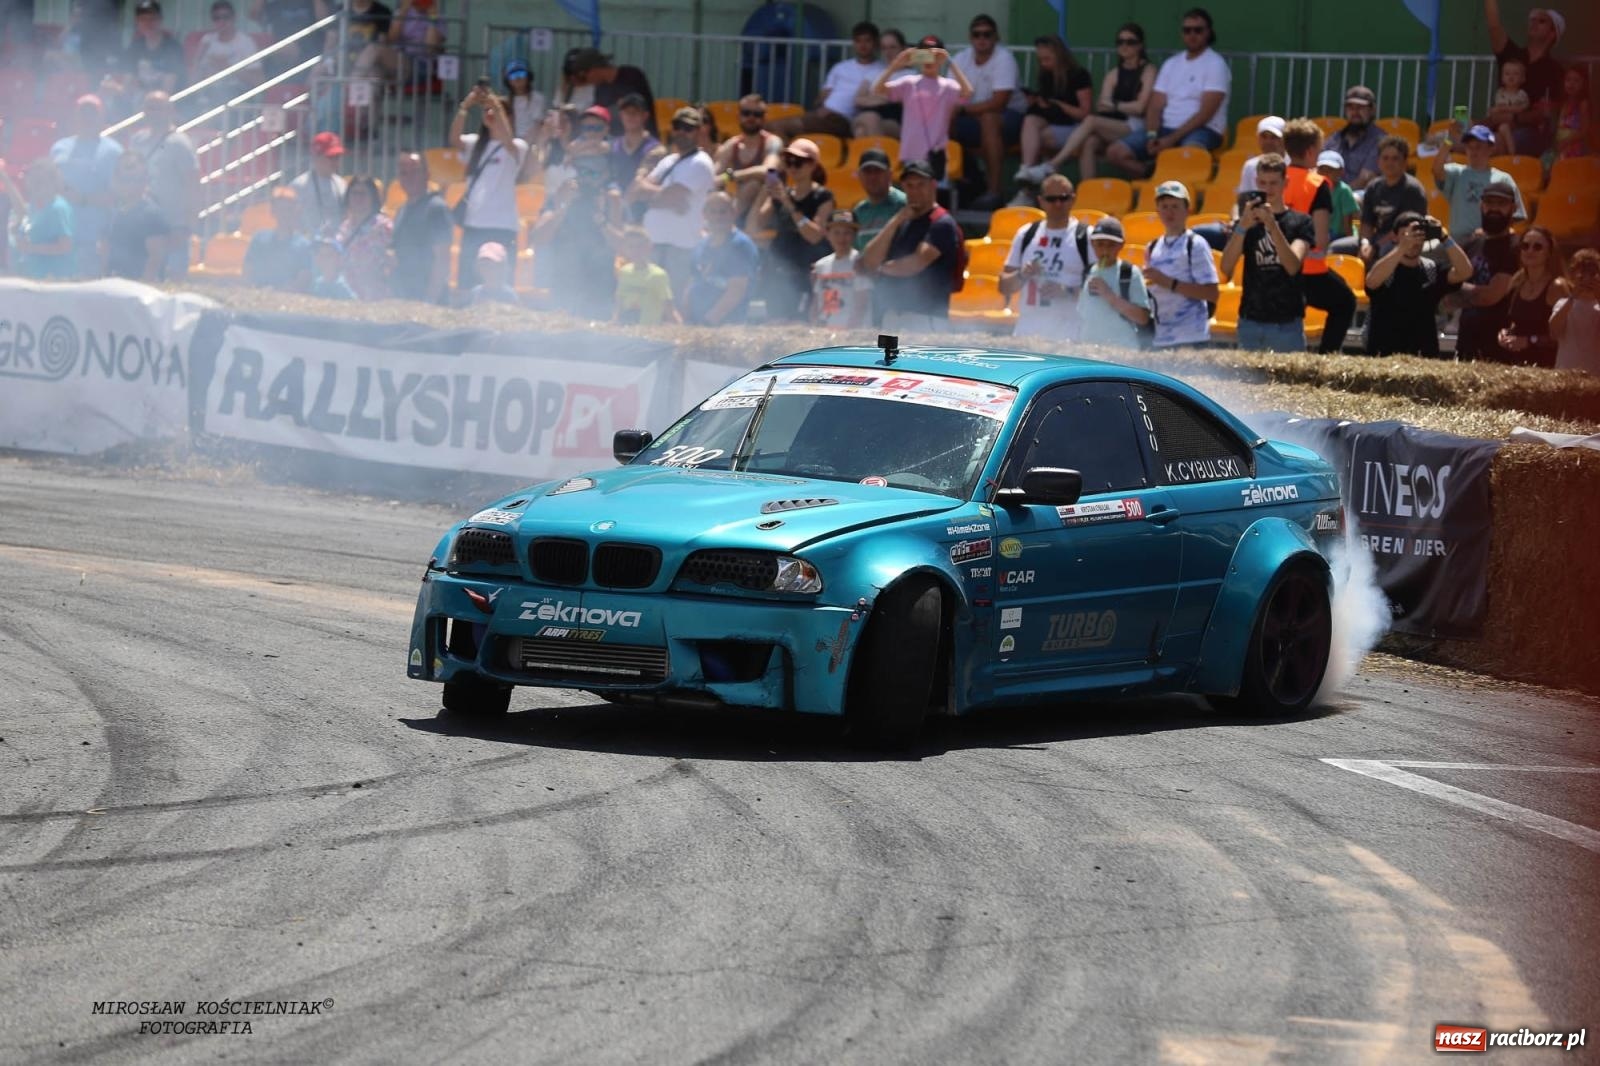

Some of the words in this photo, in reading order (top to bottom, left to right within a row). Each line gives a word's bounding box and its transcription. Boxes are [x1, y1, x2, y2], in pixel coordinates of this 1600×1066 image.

[650, 445, 725, 465] 500
[1164, 459, 1241, 482] K.CYBULSKI
[1361, 461, 1452, 519] INEOS
[1125, 501, 1142, 517] 500
[1360, 534, 1447, 557] GRENDIER
